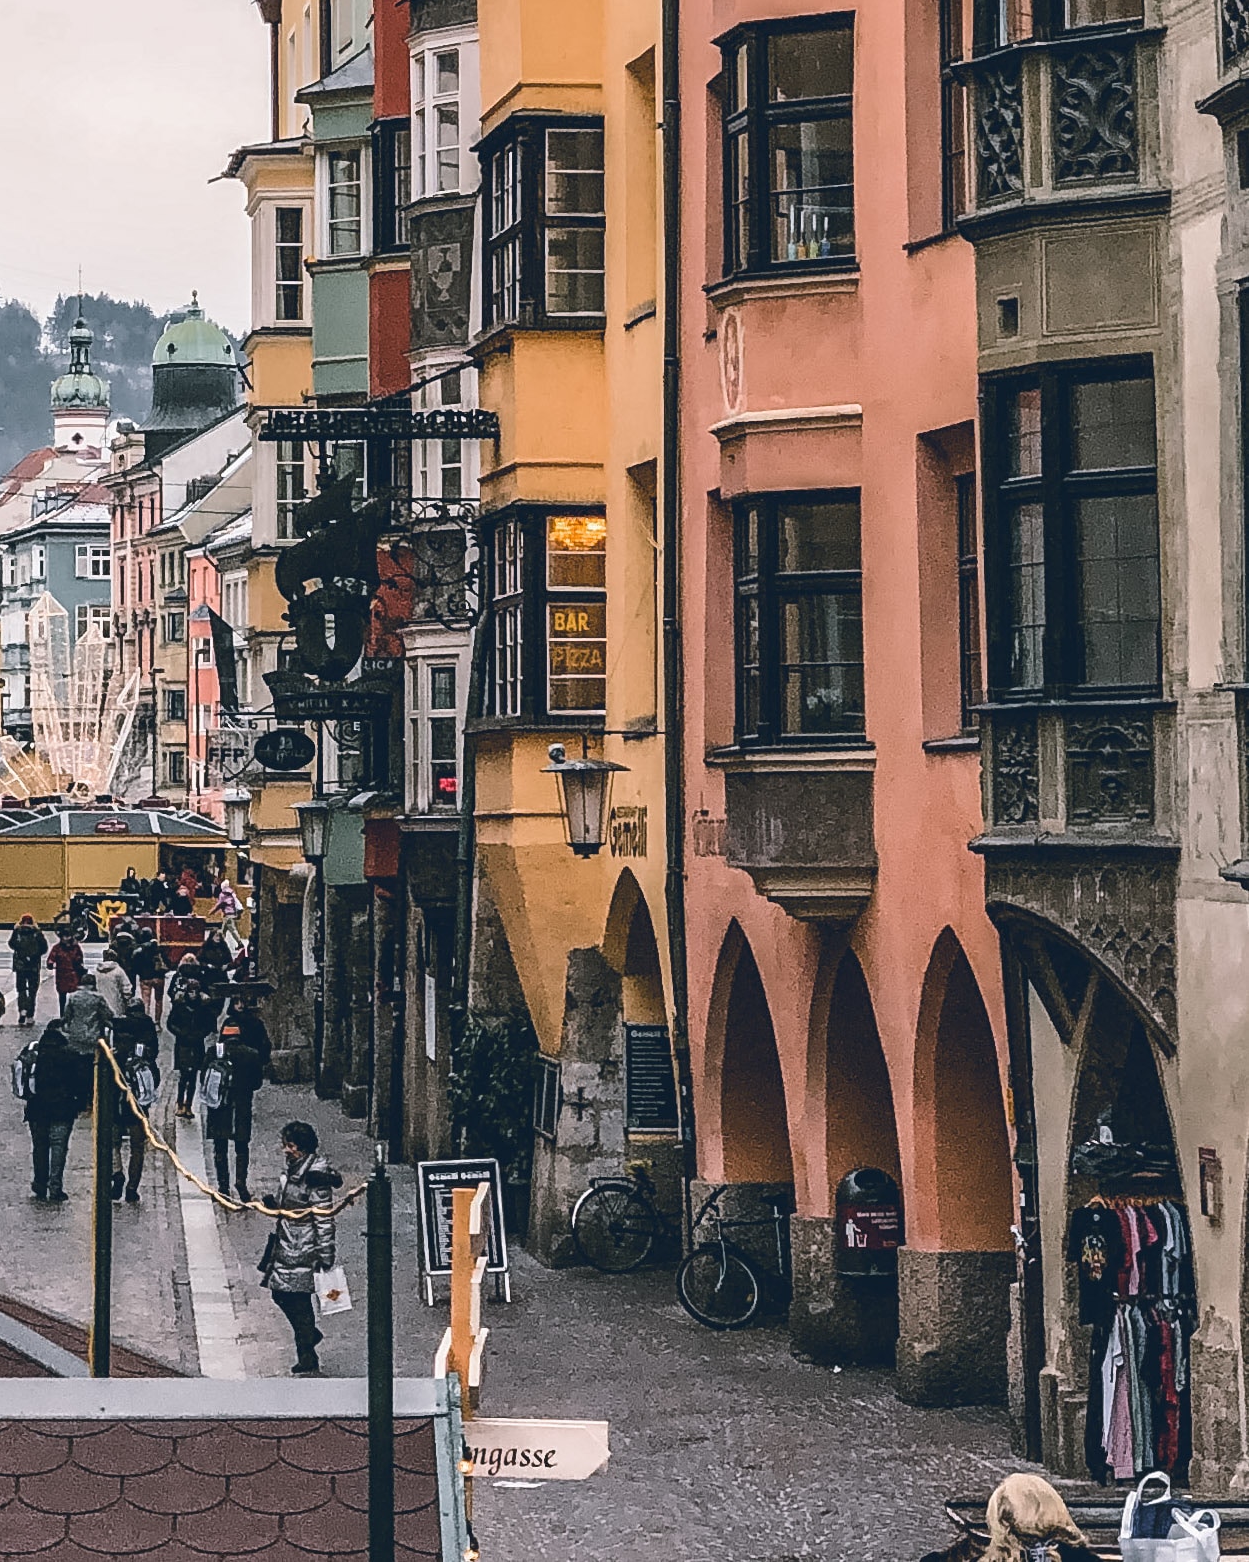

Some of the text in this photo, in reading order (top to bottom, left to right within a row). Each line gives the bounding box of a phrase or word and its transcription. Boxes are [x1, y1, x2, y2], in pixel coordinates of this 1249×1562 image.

[554, 612, 589, 631] BAR
[552, 646, 602, 669] PIZZA
[470, 1446, 557, 1476] ngasse
